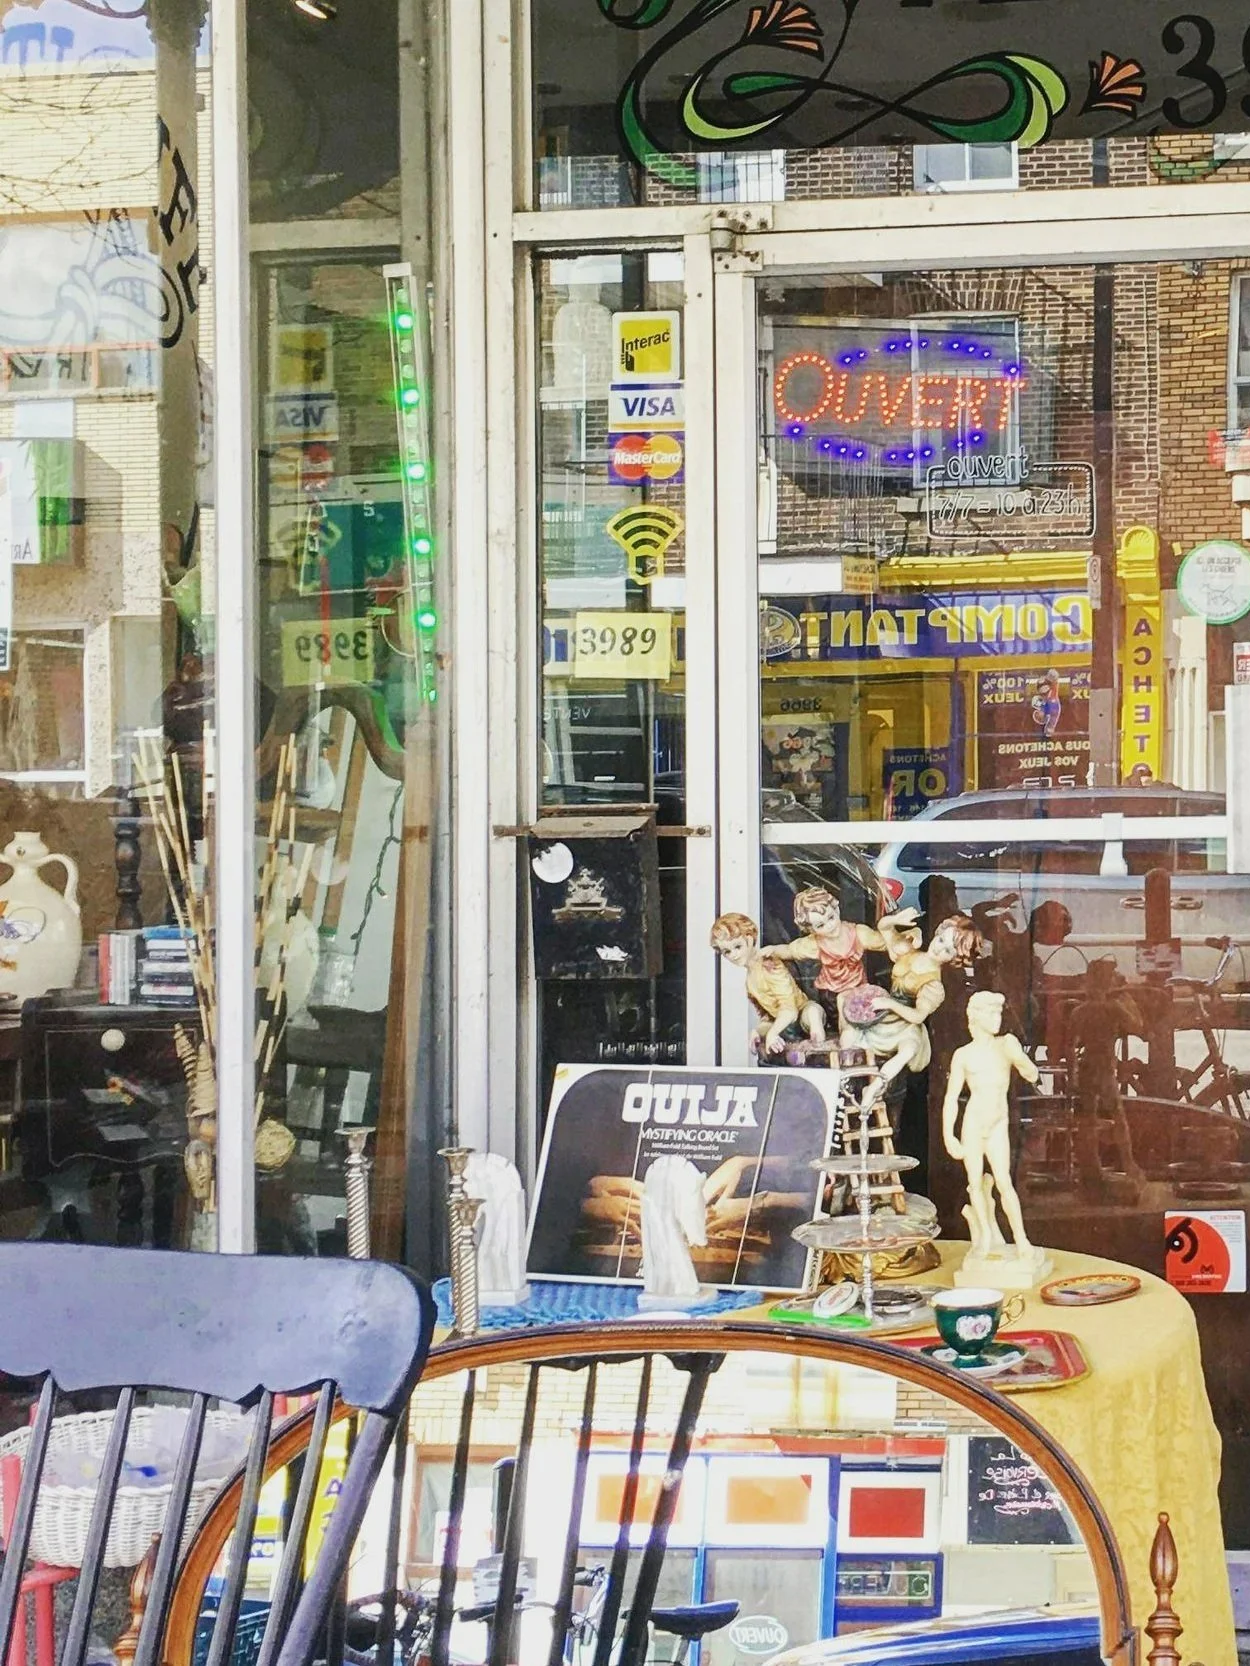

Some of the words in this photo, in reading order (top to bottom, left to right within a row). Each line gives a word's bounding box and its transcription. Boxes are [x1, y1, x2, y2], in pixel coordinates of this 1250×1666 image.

[621, 330, 671, 355] Interac
[775, 350, 1027, 430] OUVERT
[621, 396, 676, 417] VISA
[614, 452, 682, 465] MasterCard
[948, 447, 1030, 479] ouvert
[938, 494, 969, 520] 7/7
[998, 491, 1017, 516] 10
[1041, 482, 1083, 516] 23h
[578, 626, 658, 657] 3989
[622, 1083, 758, 1128] OUIJA
[640, 1128, 698, 1142] MYSTIFYING
[698, 1130, 738, 1144] ORACLE
